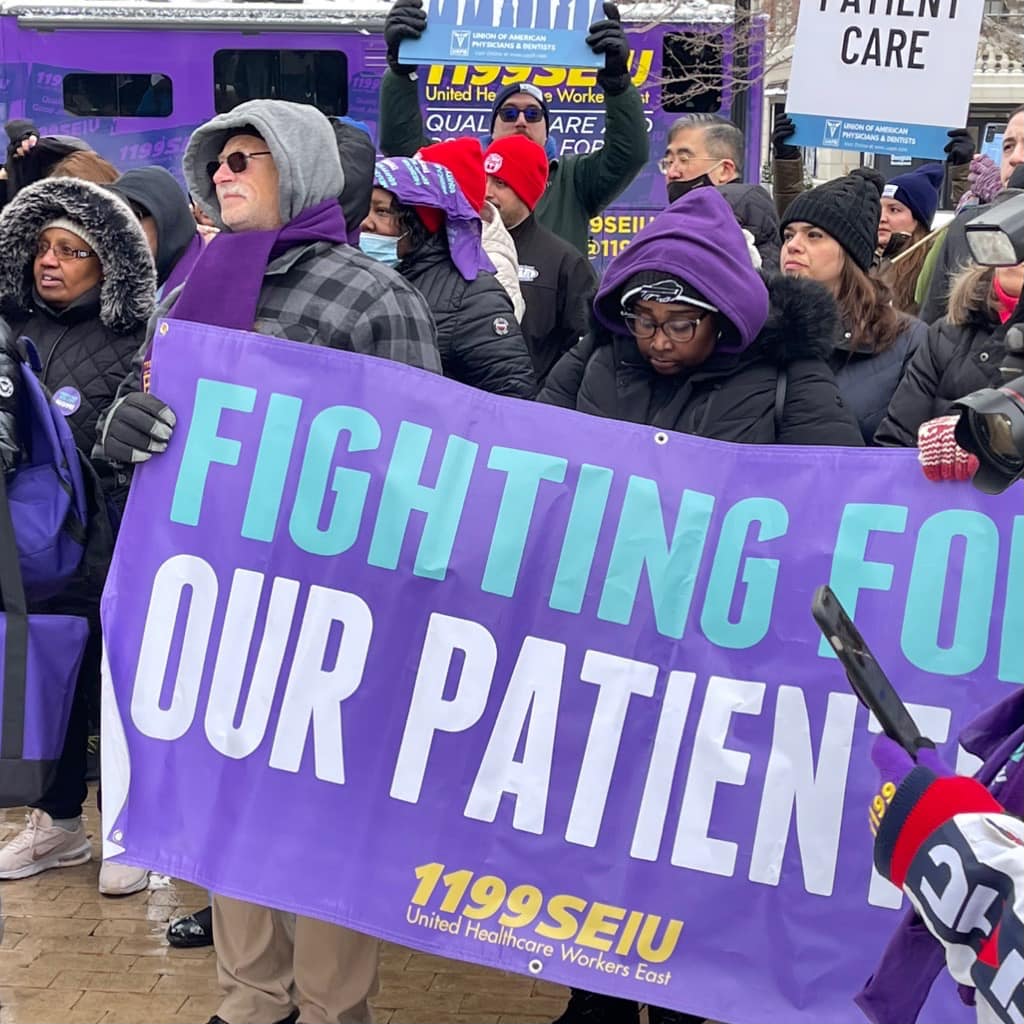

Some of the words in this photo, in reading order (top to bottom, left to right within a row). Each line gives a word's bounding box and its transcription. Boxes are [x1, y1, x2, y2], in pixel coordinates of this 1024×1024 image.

[472, 41, 514, 49] PHYSICIANS
[508, 33, 547, 42] AMERICAN
[841, 26, 930, 69] CARE
[427, 49, 654, 87] 1199SEU
[425, 85, 472, 101] United
[556, 86, 605, 103] Worke
[426, 113, 490, 132] QUAL
[549, 116, 598, 134] ARE
[843, 122, 865, 130] UNION
[875, 125, 909, 135] AMERICAN
[169, 377, 789, 650] FIGHTING
[818, 502, 1024, 684] FO
[130, 553, 373, 785] OUR
[389, 611, 985, 911] PATIEN
[411, 862, 684, 964] 1199SEIU
[406, 905, 462, 935] United
[465, 920, 554, 957] Healthcare
[560, 944, 630, 977] Workers
[635, 963, 672, 986] East
